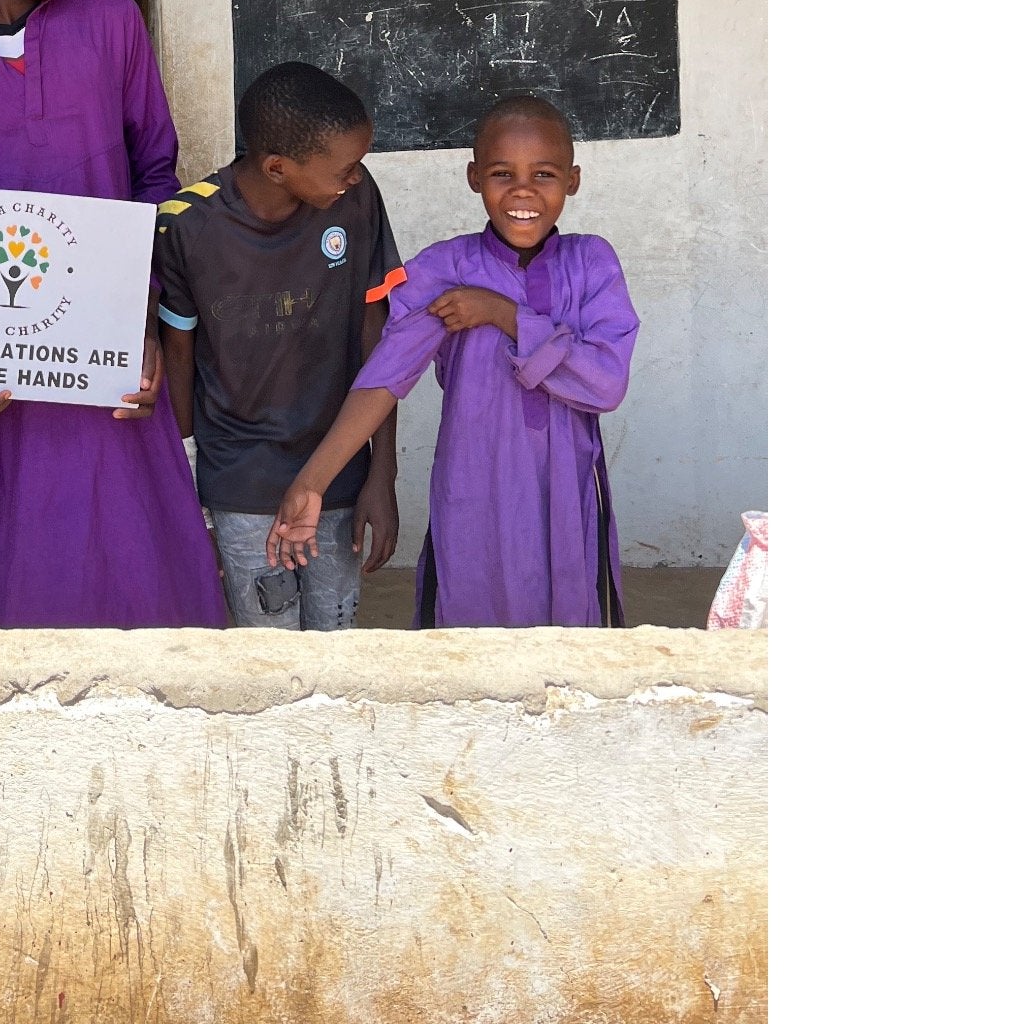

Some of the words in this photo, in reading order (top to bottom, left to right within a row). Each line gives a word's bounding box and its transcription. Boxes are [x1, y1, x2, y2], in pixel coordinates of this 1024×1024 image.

[12, 202, 78, 248] CHARITY
[5, 296, 72, 337] CHARITY
[88, 349, 129, 368] ARE
[17, 369, 89, 390] HANDS
